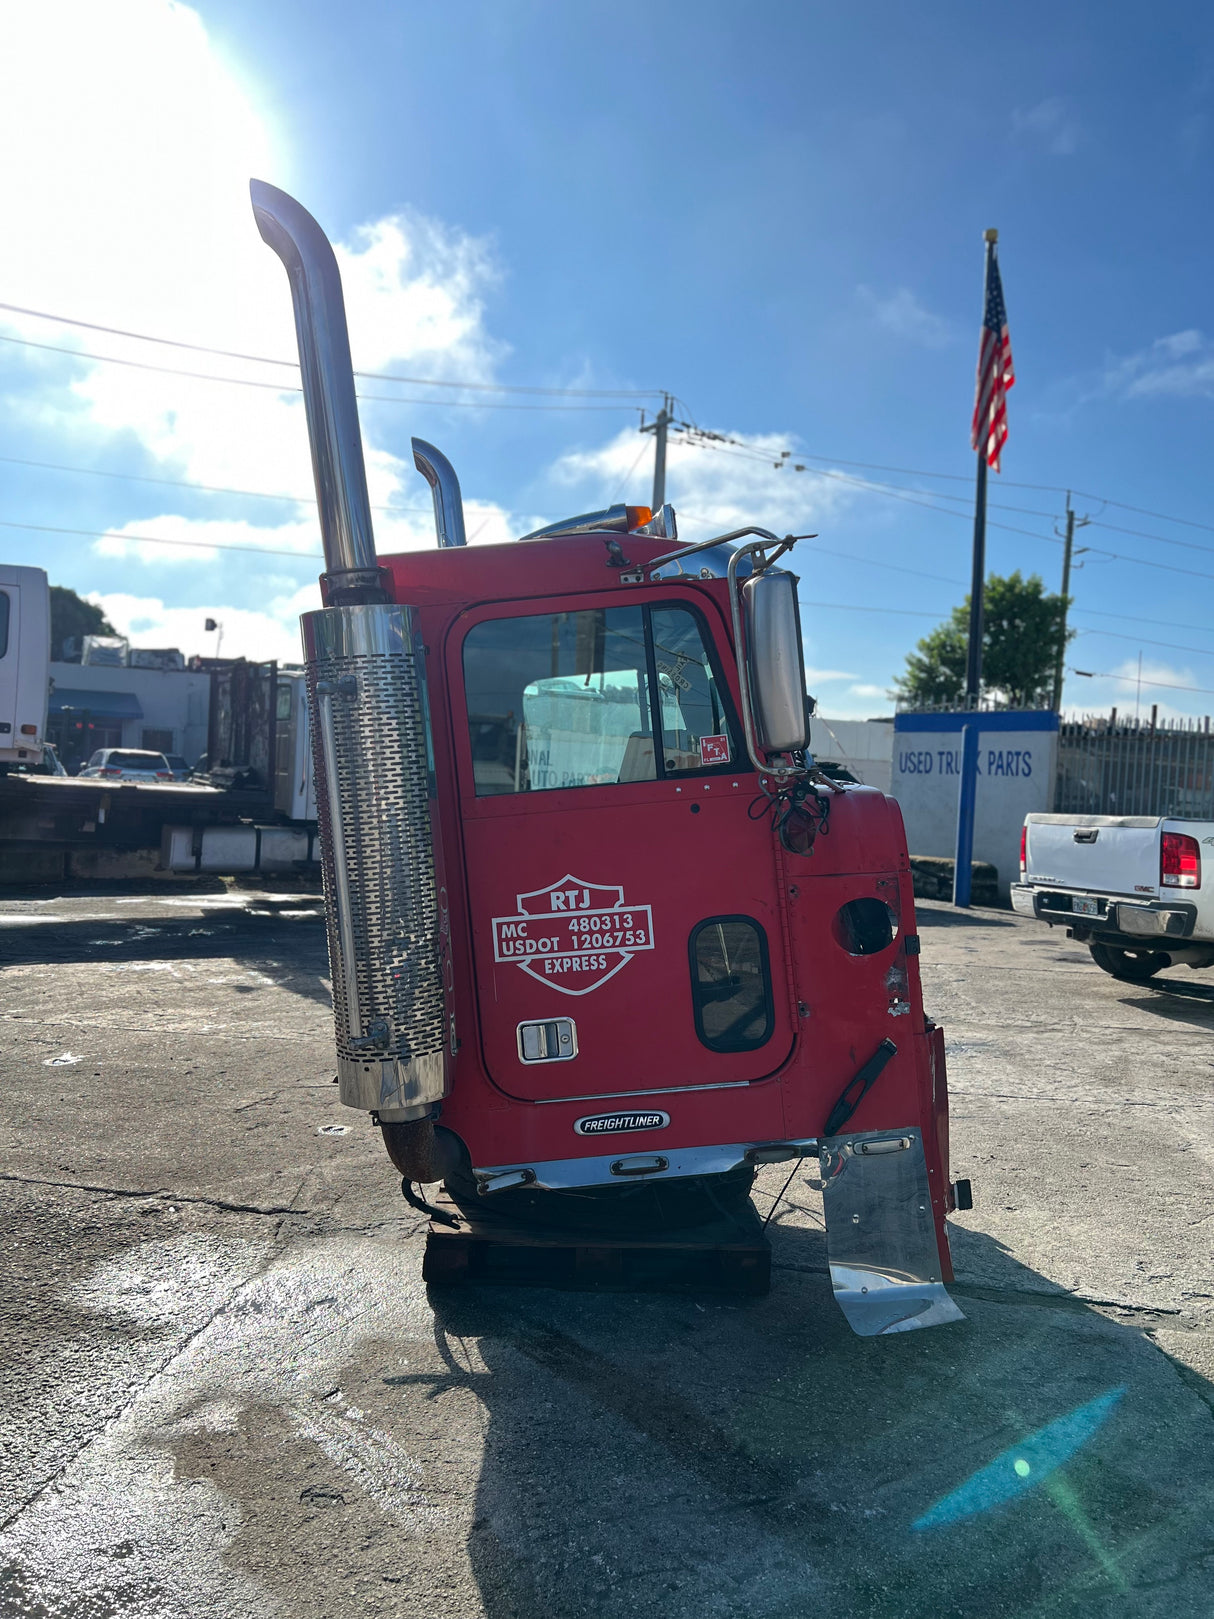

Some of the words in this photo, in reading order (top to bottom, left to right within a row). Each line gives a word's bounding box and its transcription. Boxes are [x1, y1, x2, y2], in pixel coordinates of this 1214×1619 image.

[899, 751, 933, 774] USED
[987, 750, 1032, 777] PARTS
[550, 889, 591, 911] RTJ
[1134, 885, 1155, 893] GMC
[501, 923, 528, 938] MC
[568, 914, 634, 932] 480313
[502, 937, 560, 955] USDOT
[571, 930, 646, 949] 1206753
[544, 955, 607, 974] EXPRESS
[584, 1115, 660, 1131] FREIGHTLINER
